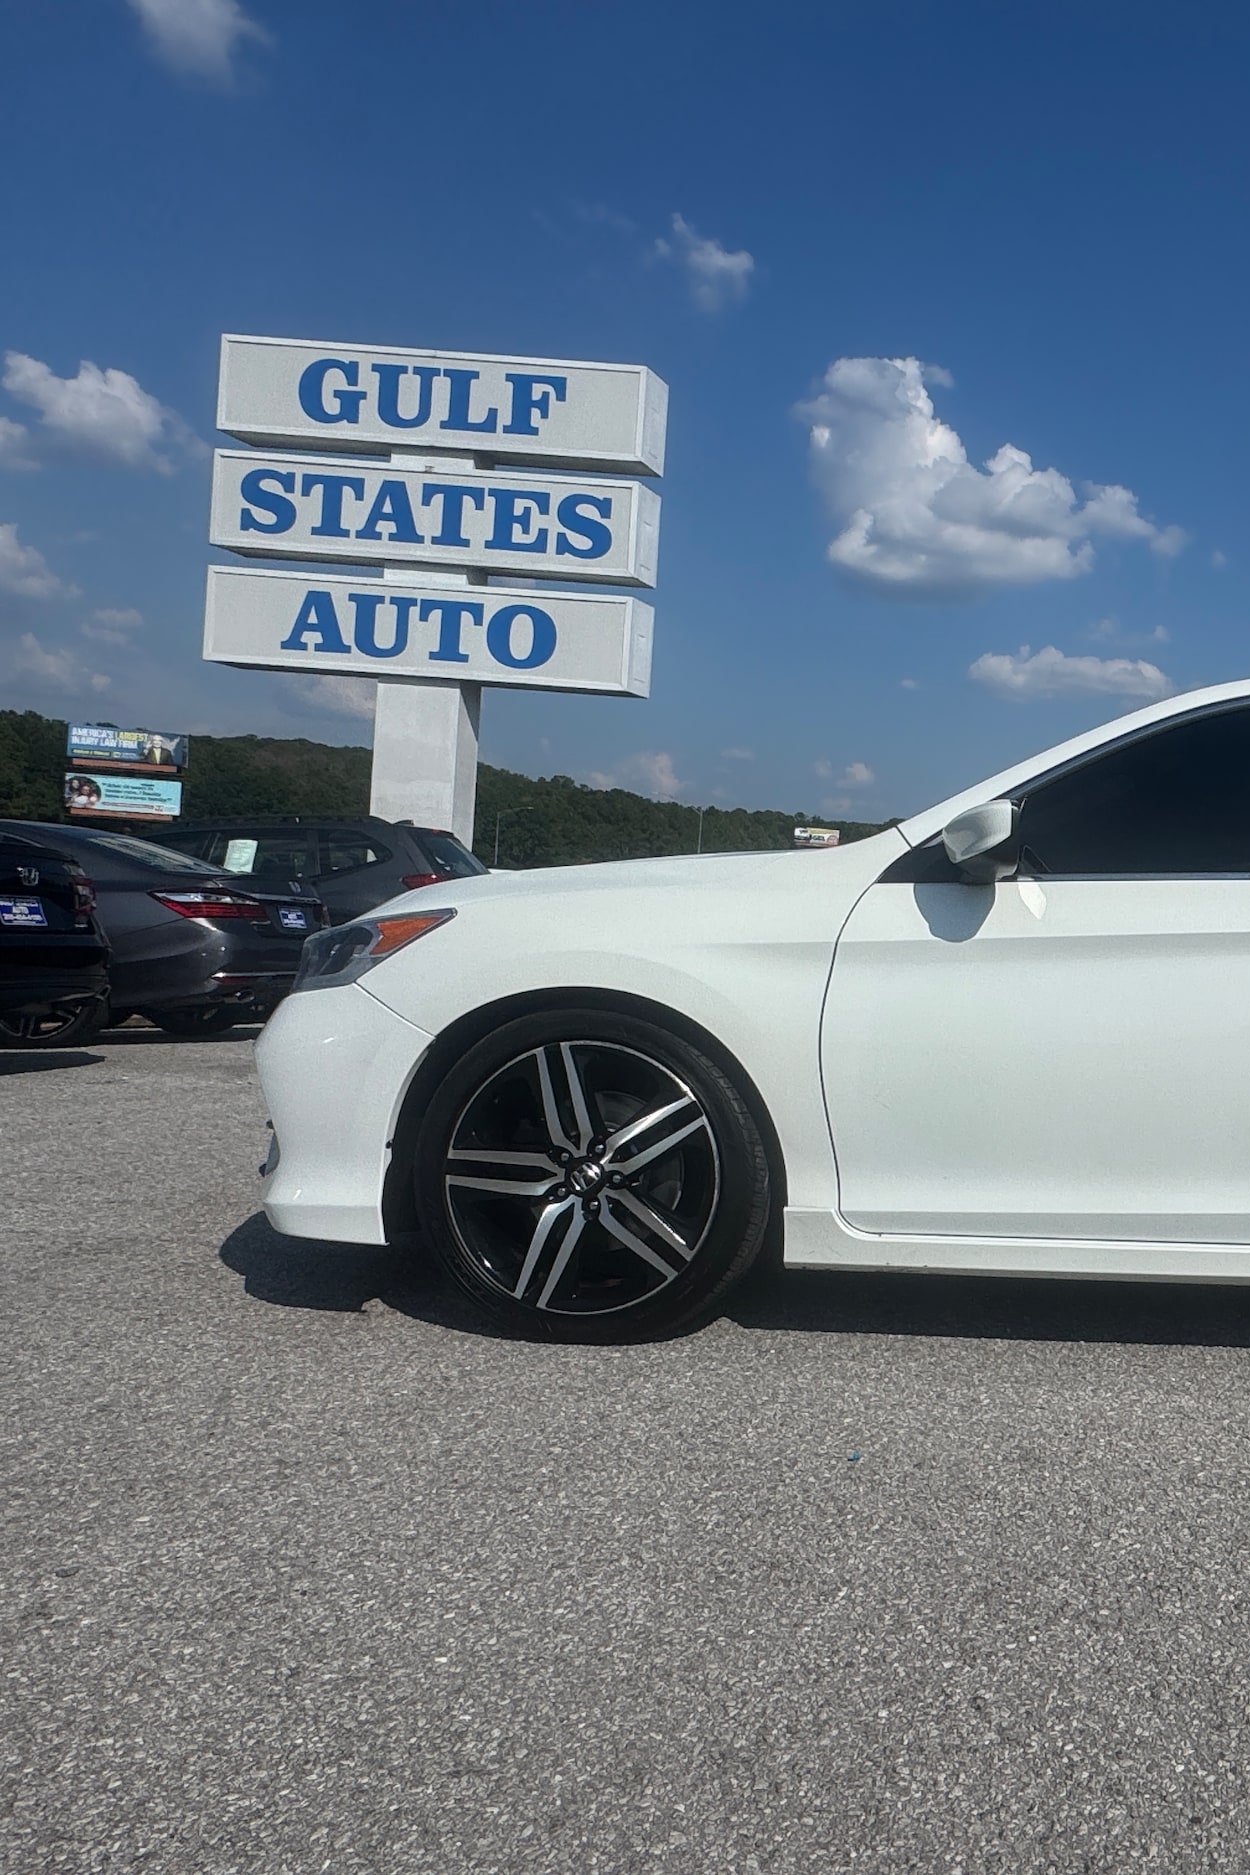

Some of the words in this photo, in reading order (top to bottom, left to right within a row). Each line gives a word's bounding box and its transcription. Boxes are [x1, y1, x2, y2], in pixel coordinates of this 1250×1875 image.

[298, 358, 567, 436] GULF
[240, 469, 612, 559] STATES
[281, 590, 557, 669] AUTO
[72, 727, 114, 739] AMERICA'S
[100, 738, 117, 748] LAW
